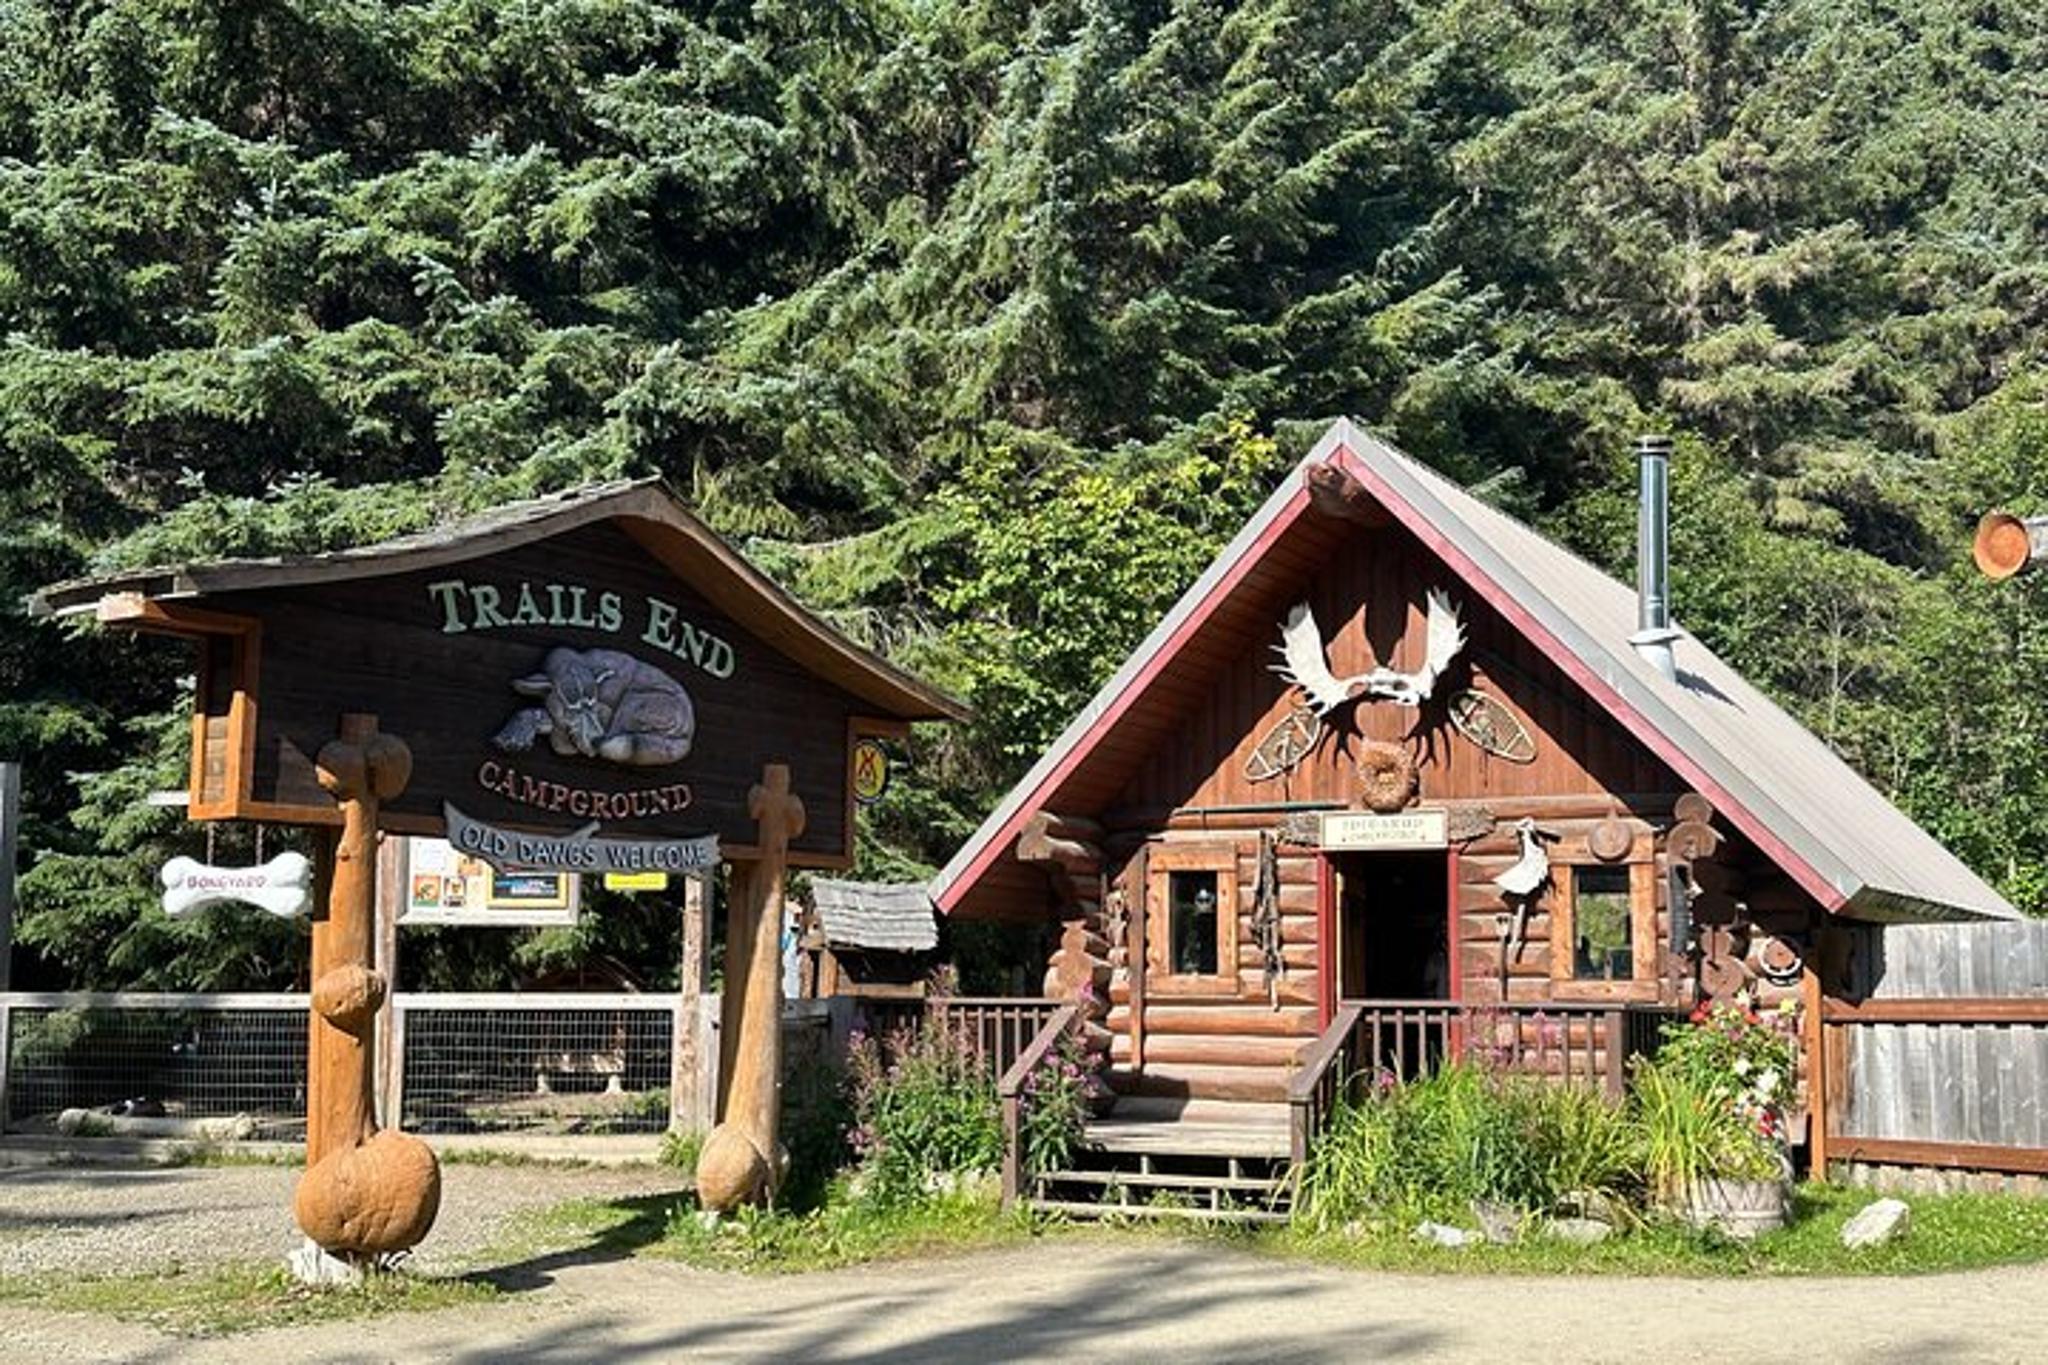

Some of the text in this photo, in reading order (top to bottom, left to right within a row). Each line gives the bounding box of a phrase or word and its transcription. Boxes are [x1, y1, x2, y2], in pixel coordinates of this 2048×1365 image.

[428, 579, 736, 679] TRAILS END
[478, 760, 692, 820] CAMPGROUND
[460, 823, 709, 869] OLD DAWGS WELCOME
[186, 874, 268, 890] BONEYARD
